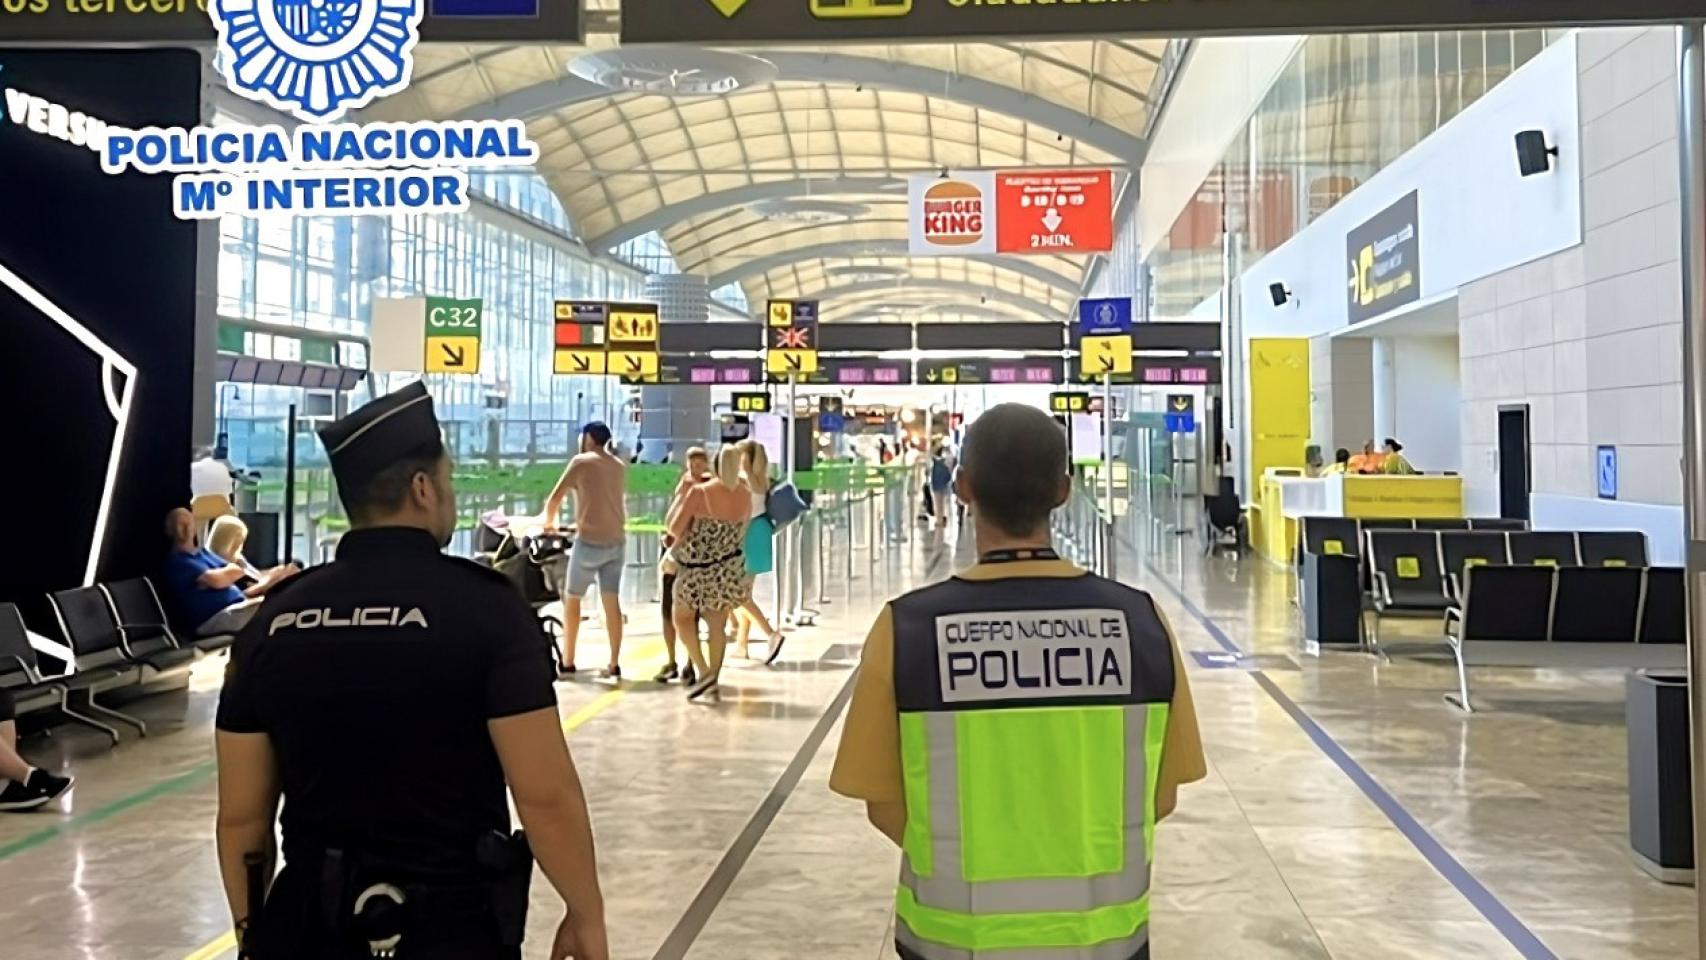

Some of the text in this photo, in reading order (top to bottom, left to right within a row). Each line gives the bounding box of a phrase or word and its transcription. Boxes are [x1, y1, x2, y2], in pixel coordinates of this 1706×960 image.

[924, 200, 982, 214] GER
[924, 215, 982, 234] KING
[429, 307, 477, 328] C32
[268, 606, 429, 637] POLICIA
[947, 647, 1123, 690] POLICIA
